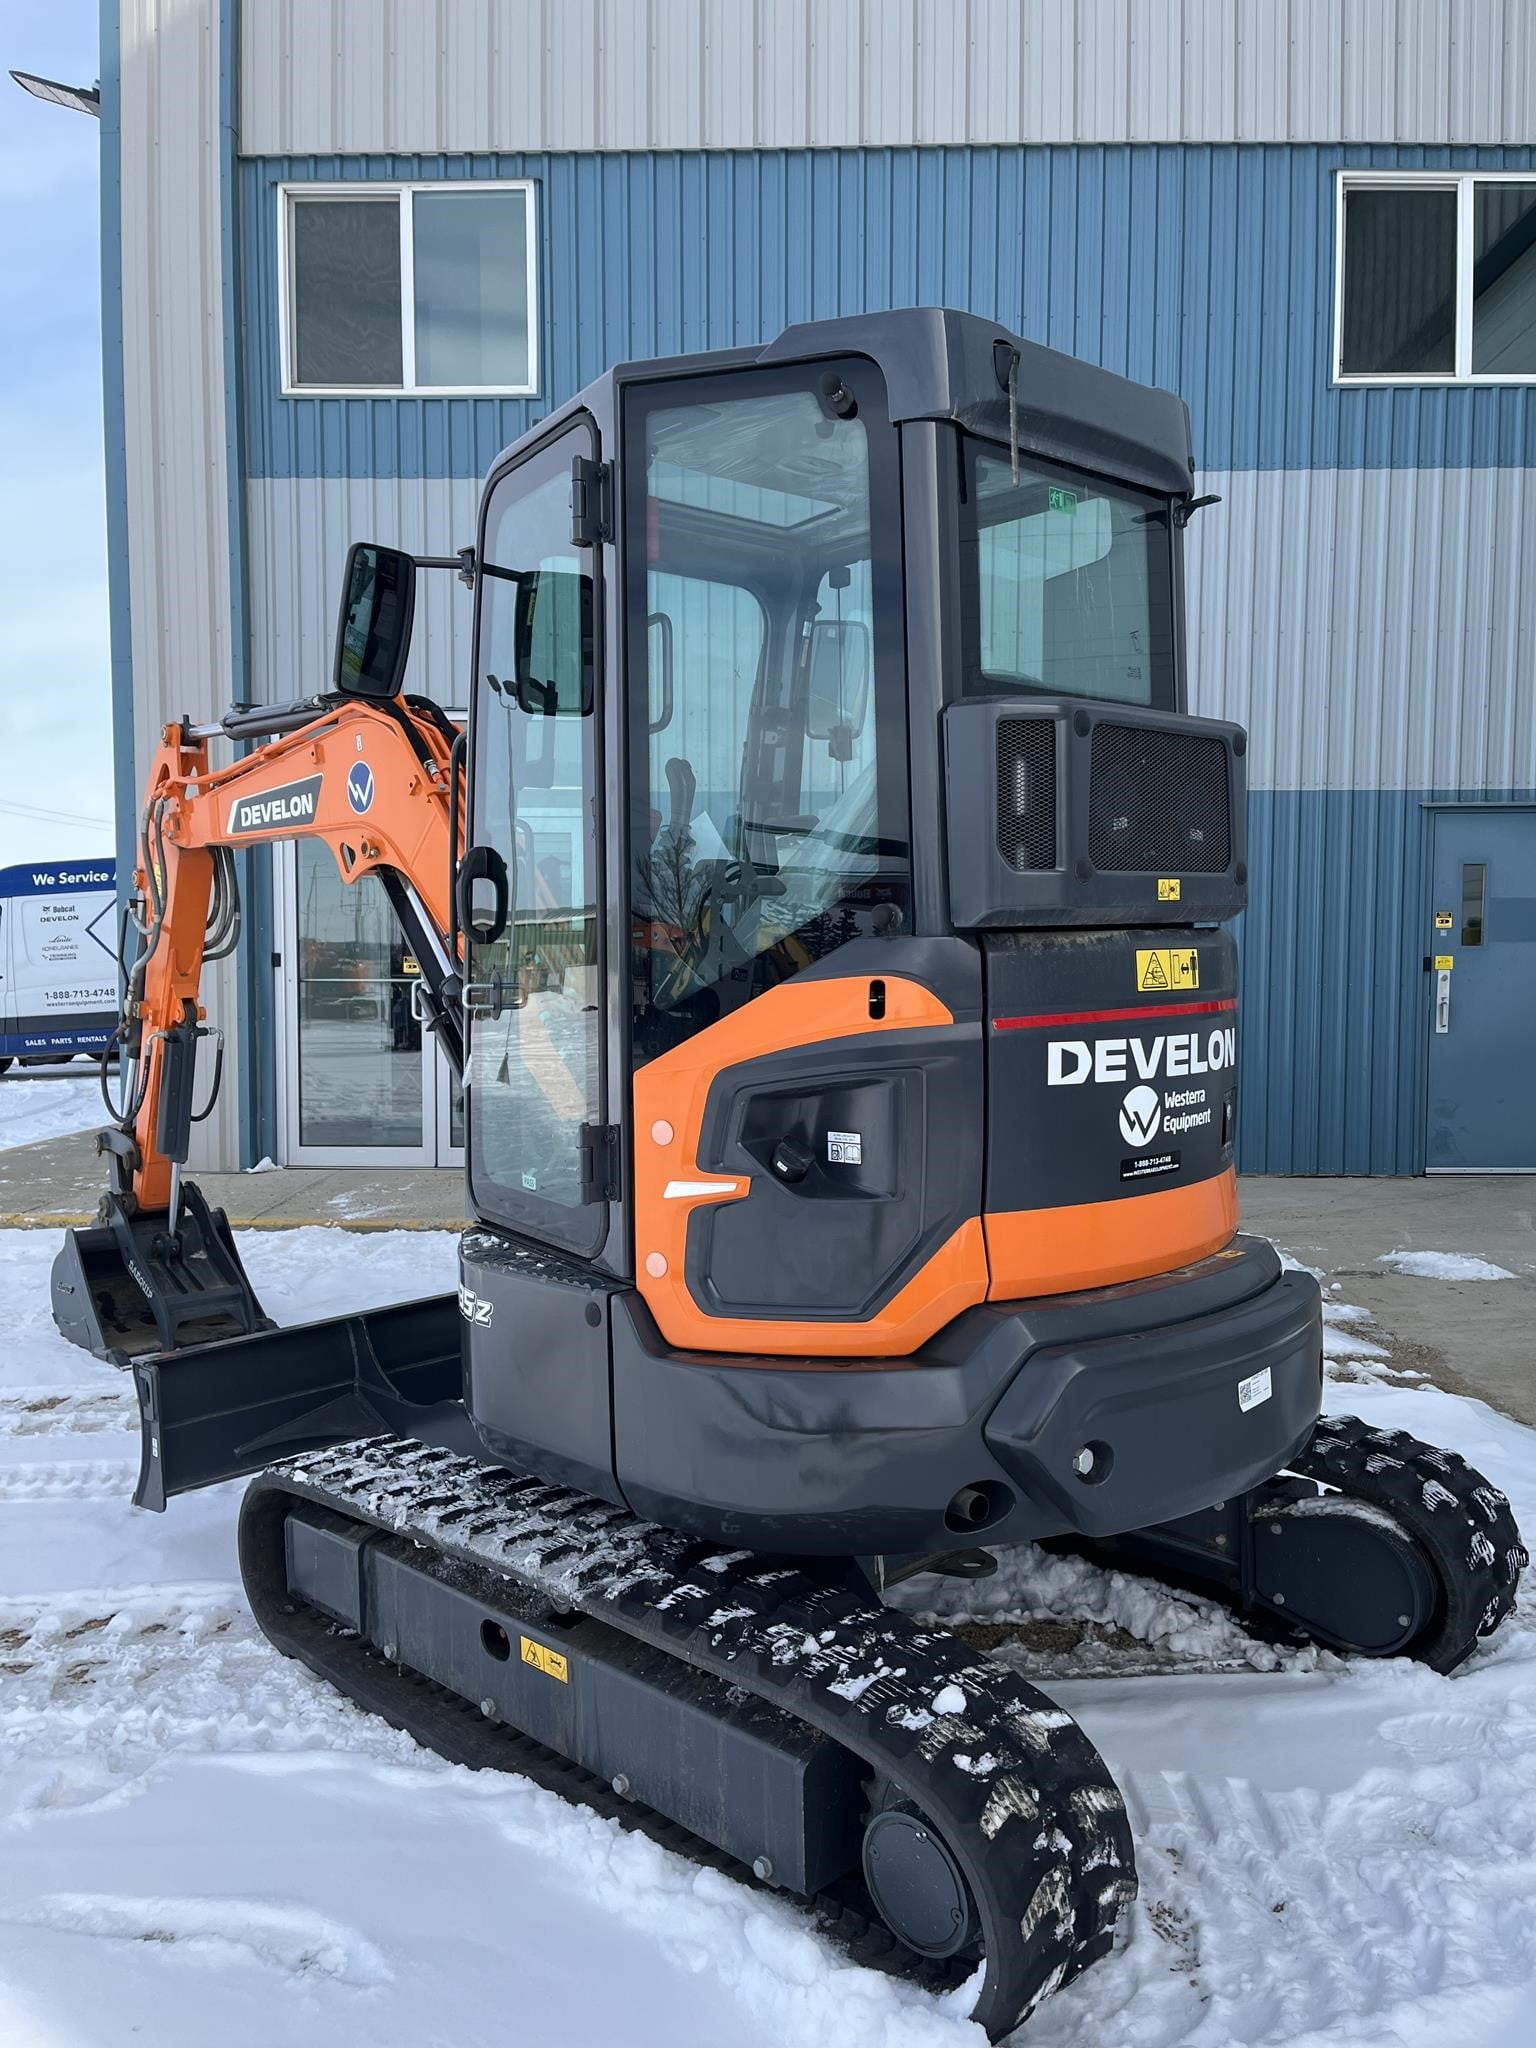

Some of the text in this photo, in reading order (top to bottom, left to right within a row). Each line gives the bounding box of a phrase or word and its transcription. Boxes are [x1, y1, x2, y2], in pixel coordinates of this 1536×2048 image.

[240, 793, 313, 827] DEVELON
[32, 873, 55, 886] We
[58, 870, 109, 885] Service
[40, 914, 79, 923] DEVELON
[45, 988, 115, 1000] 1-888-713-4748
[25, 1038, 47, 1047] SALES
[51, 1037, 73, 1045] PARTS
[77, 1035, 107, 1044] RENTALS
[1047, 1027, 1236, 1086] DEVELON
[1164, 1089, 1206, 1109] Westerra
[1163, 1108, 1211, 1135] Equipment
